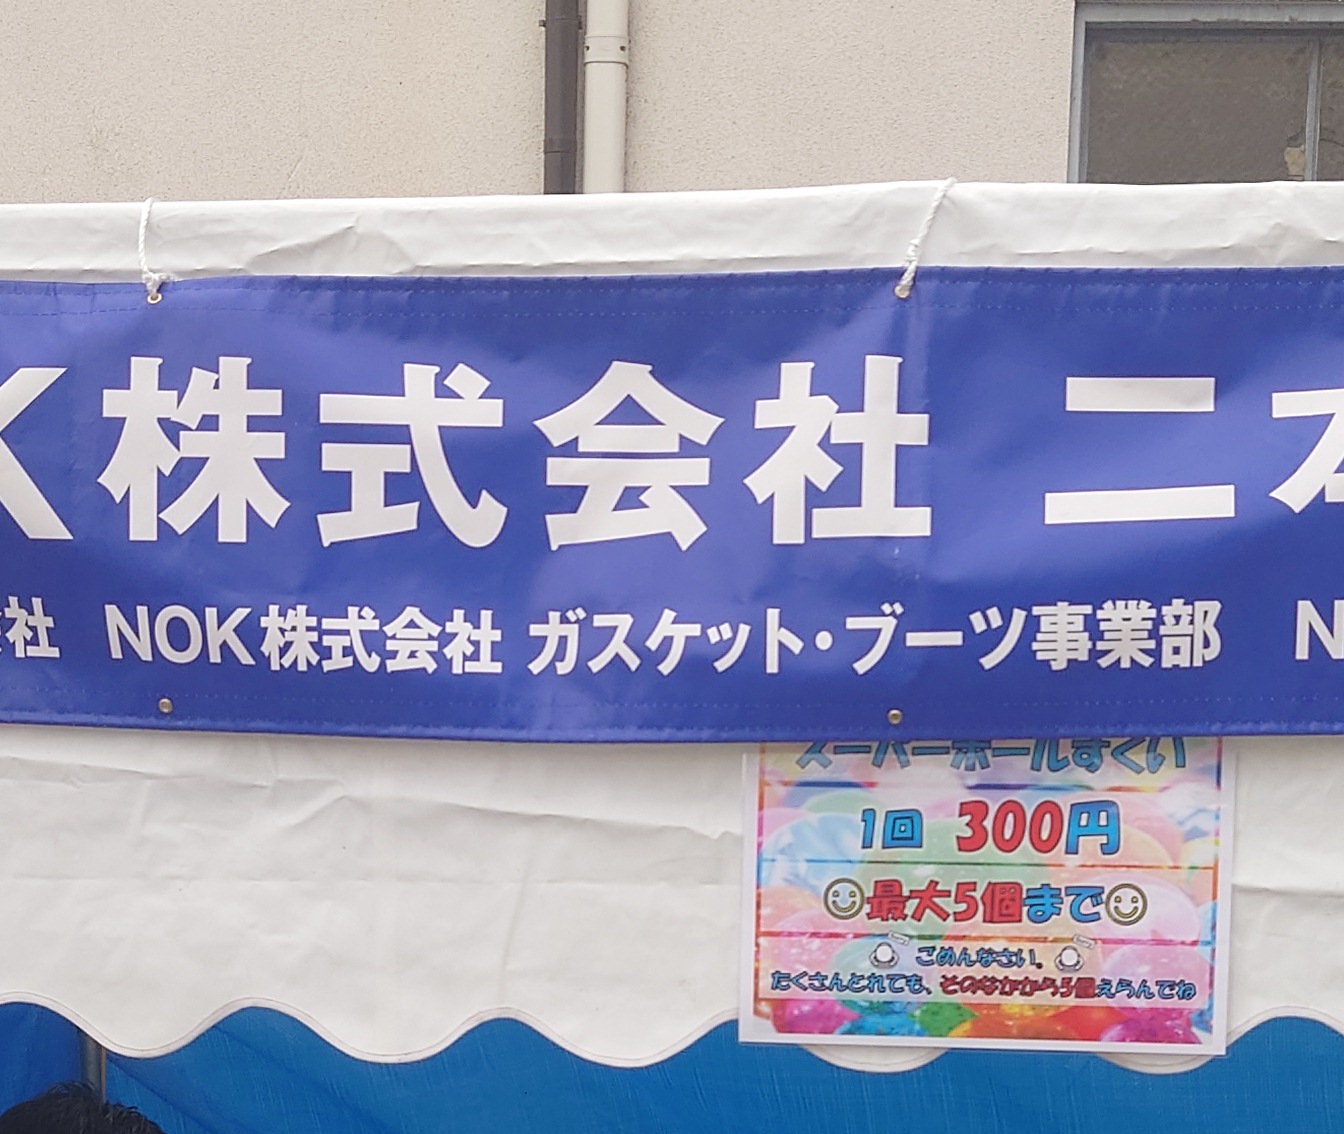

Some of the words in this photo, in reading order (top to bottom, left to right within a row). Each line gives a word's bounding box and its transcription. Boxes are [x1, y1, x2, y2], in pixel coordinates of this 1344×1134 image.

[104, 603, 503, 675] NOK株式会社
[527, 598, 1222, 677] ガスケット・ブーツ事業部
[861, 808, 924, 850] 1回
[955, 799, 1121, 856] 300円
[866, 878, 1106, 925] 最大5個まで
